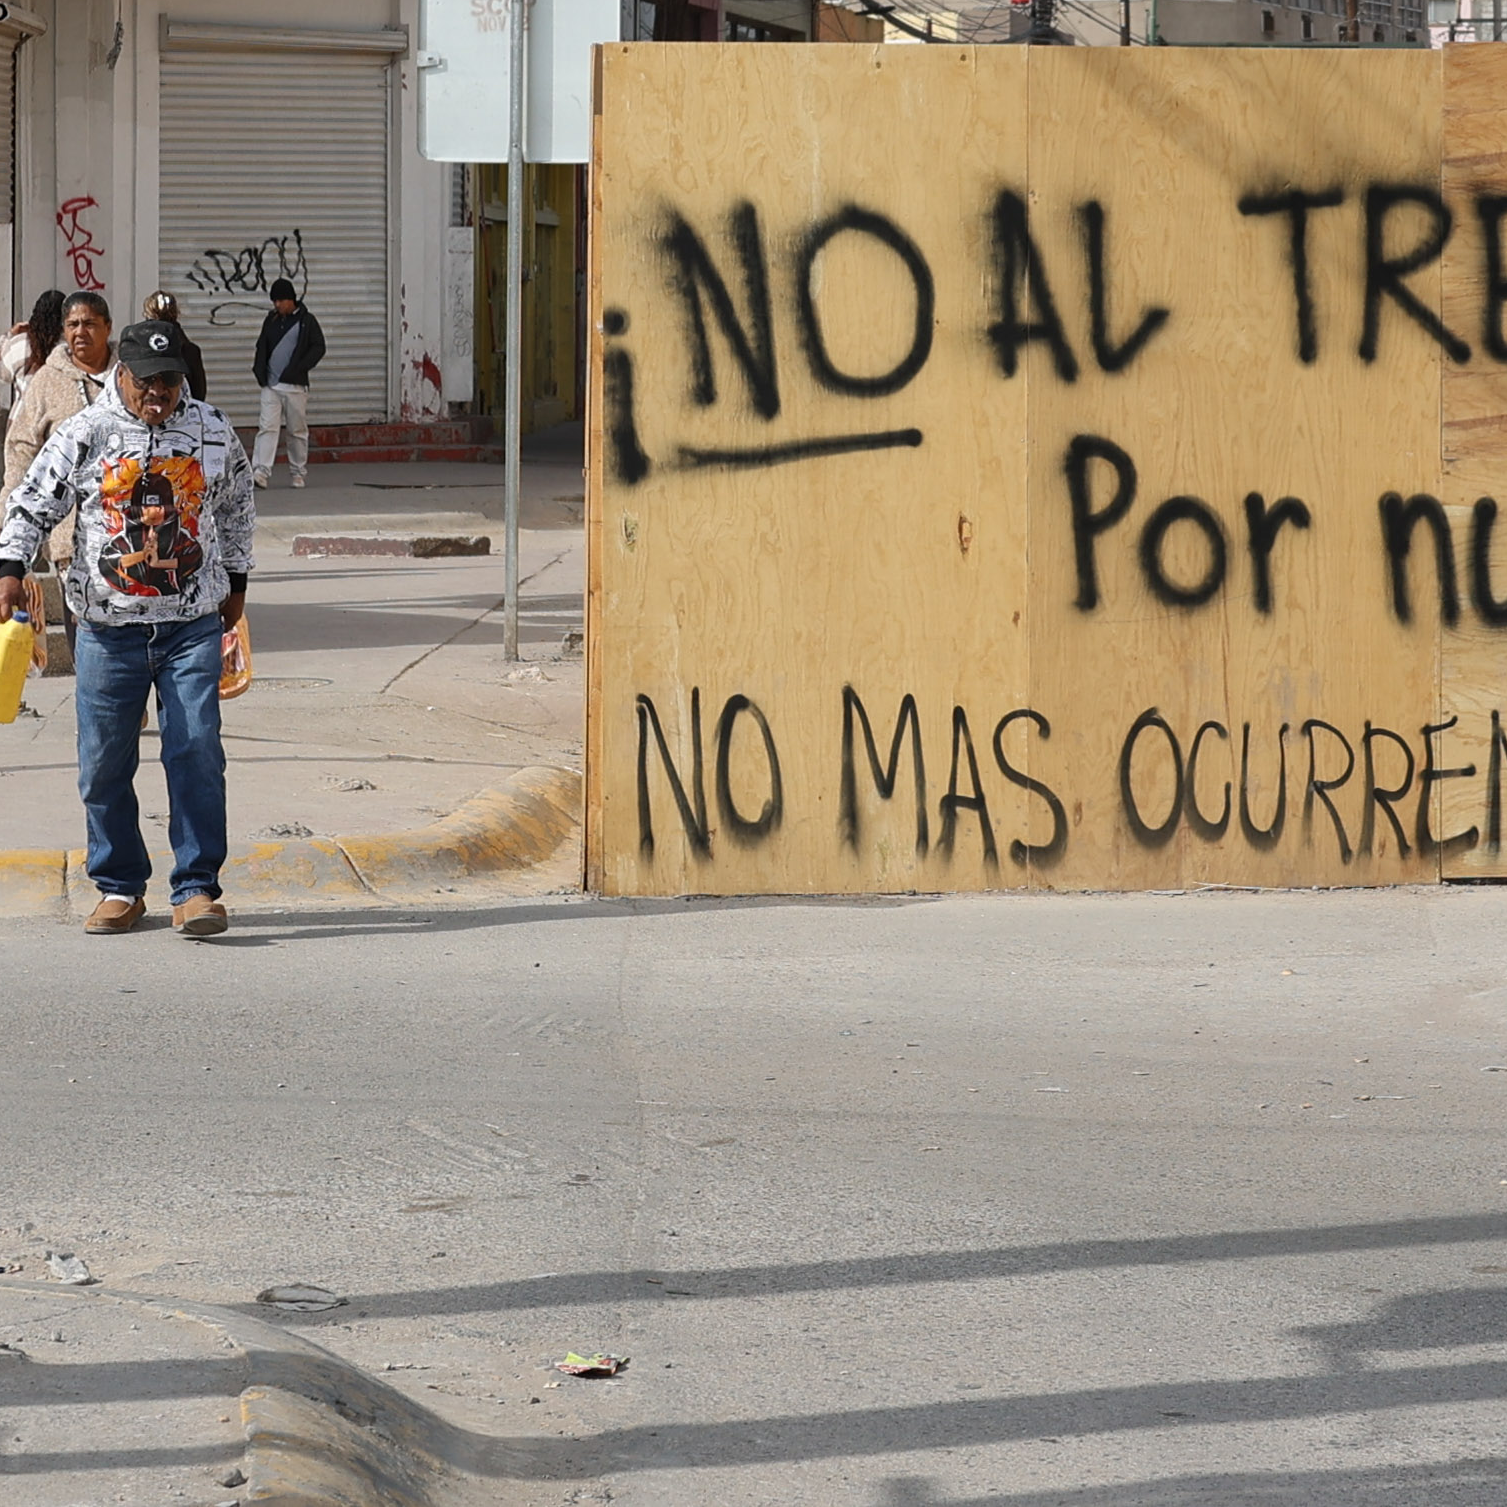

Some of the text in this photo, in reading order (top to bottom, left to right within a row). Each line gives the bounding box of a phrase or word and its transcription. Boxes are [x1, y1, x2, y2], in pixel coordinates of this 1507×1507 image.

[984, 189, 1171, 386] AL
[1063, 449, 1313, 615] Por
[636, 686, 784, 861] NO
[838, 681, 1068, 869] MAS
